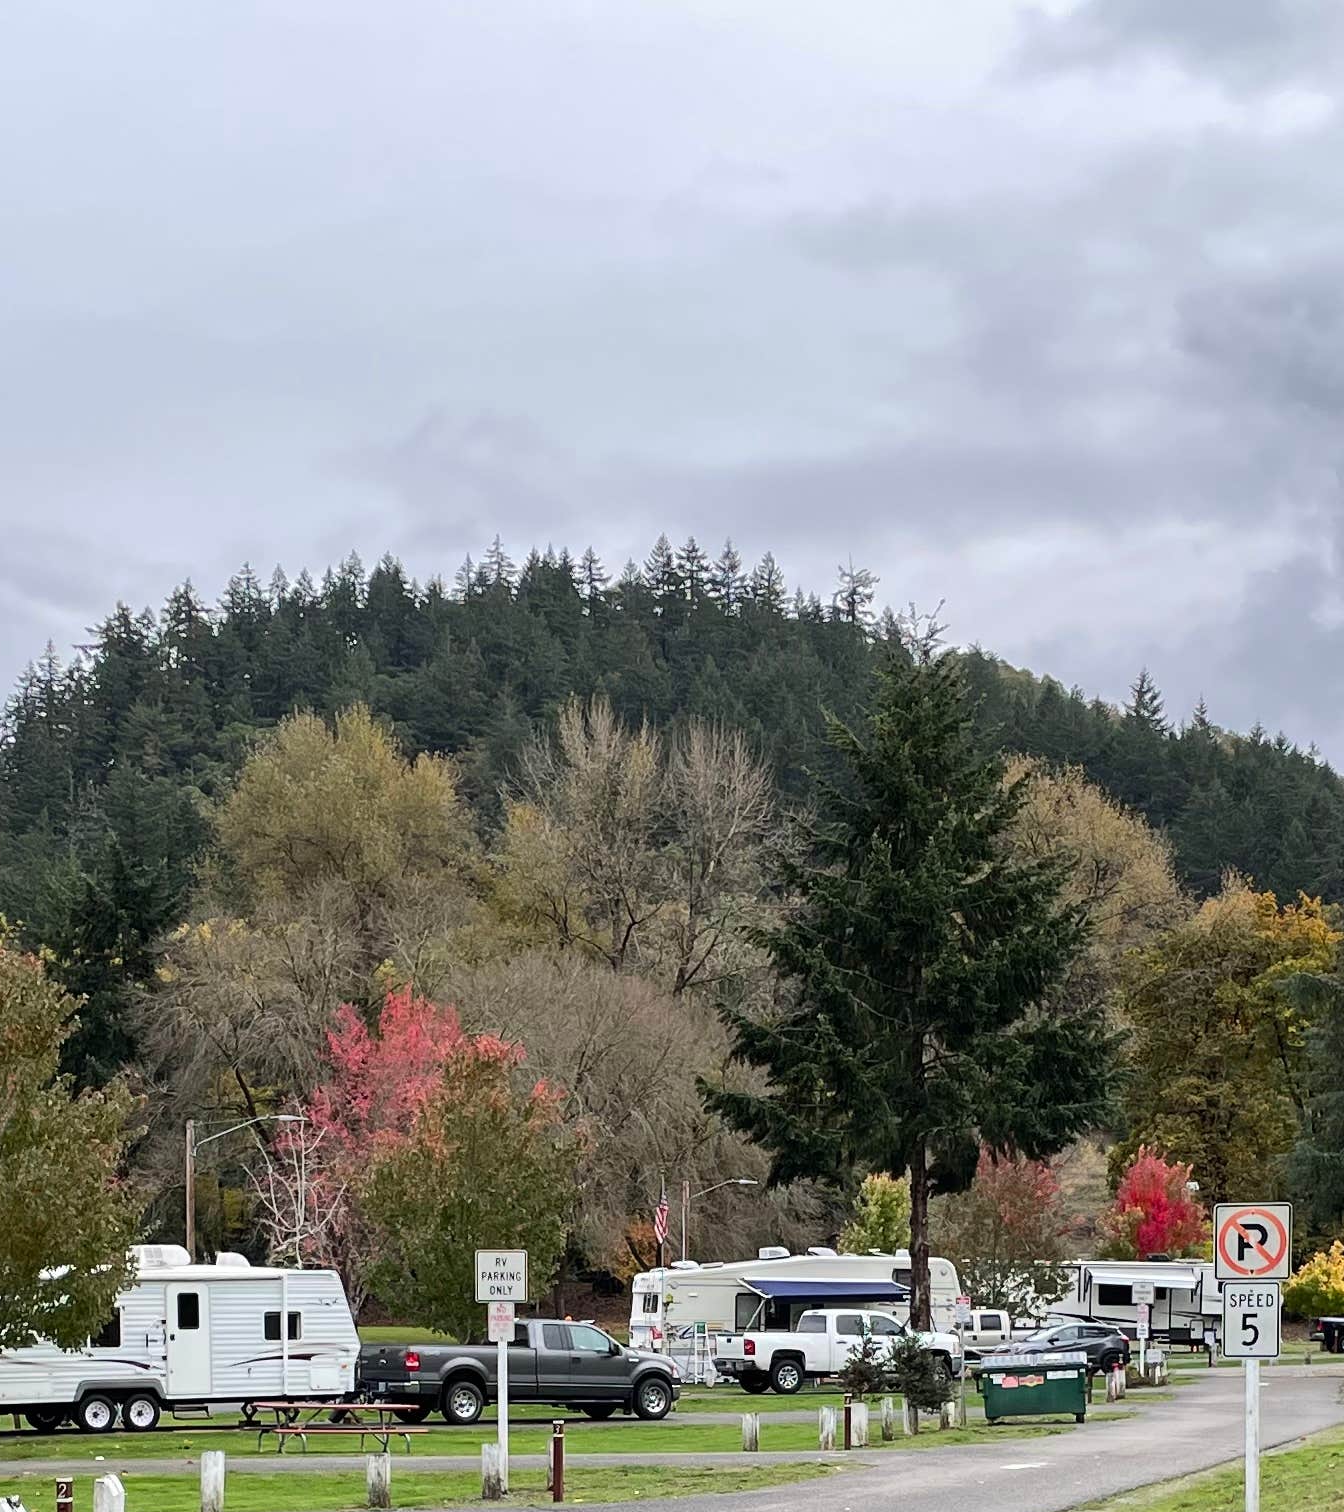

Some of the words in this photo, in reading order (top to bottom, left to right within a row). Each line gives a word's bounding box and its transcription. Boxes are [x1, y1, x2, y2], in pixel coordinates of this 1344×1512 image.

[495, 1257, 508, 1267] RV
[481, 1271, 522, 1281] PARKING
[489, 1285, 513, 1295] ONLY
[1229, 1293, 1274, 1308] SPEED
[1241, 1313, 1259, 1346] 5
[57, 1483, 67, 1498] 2
